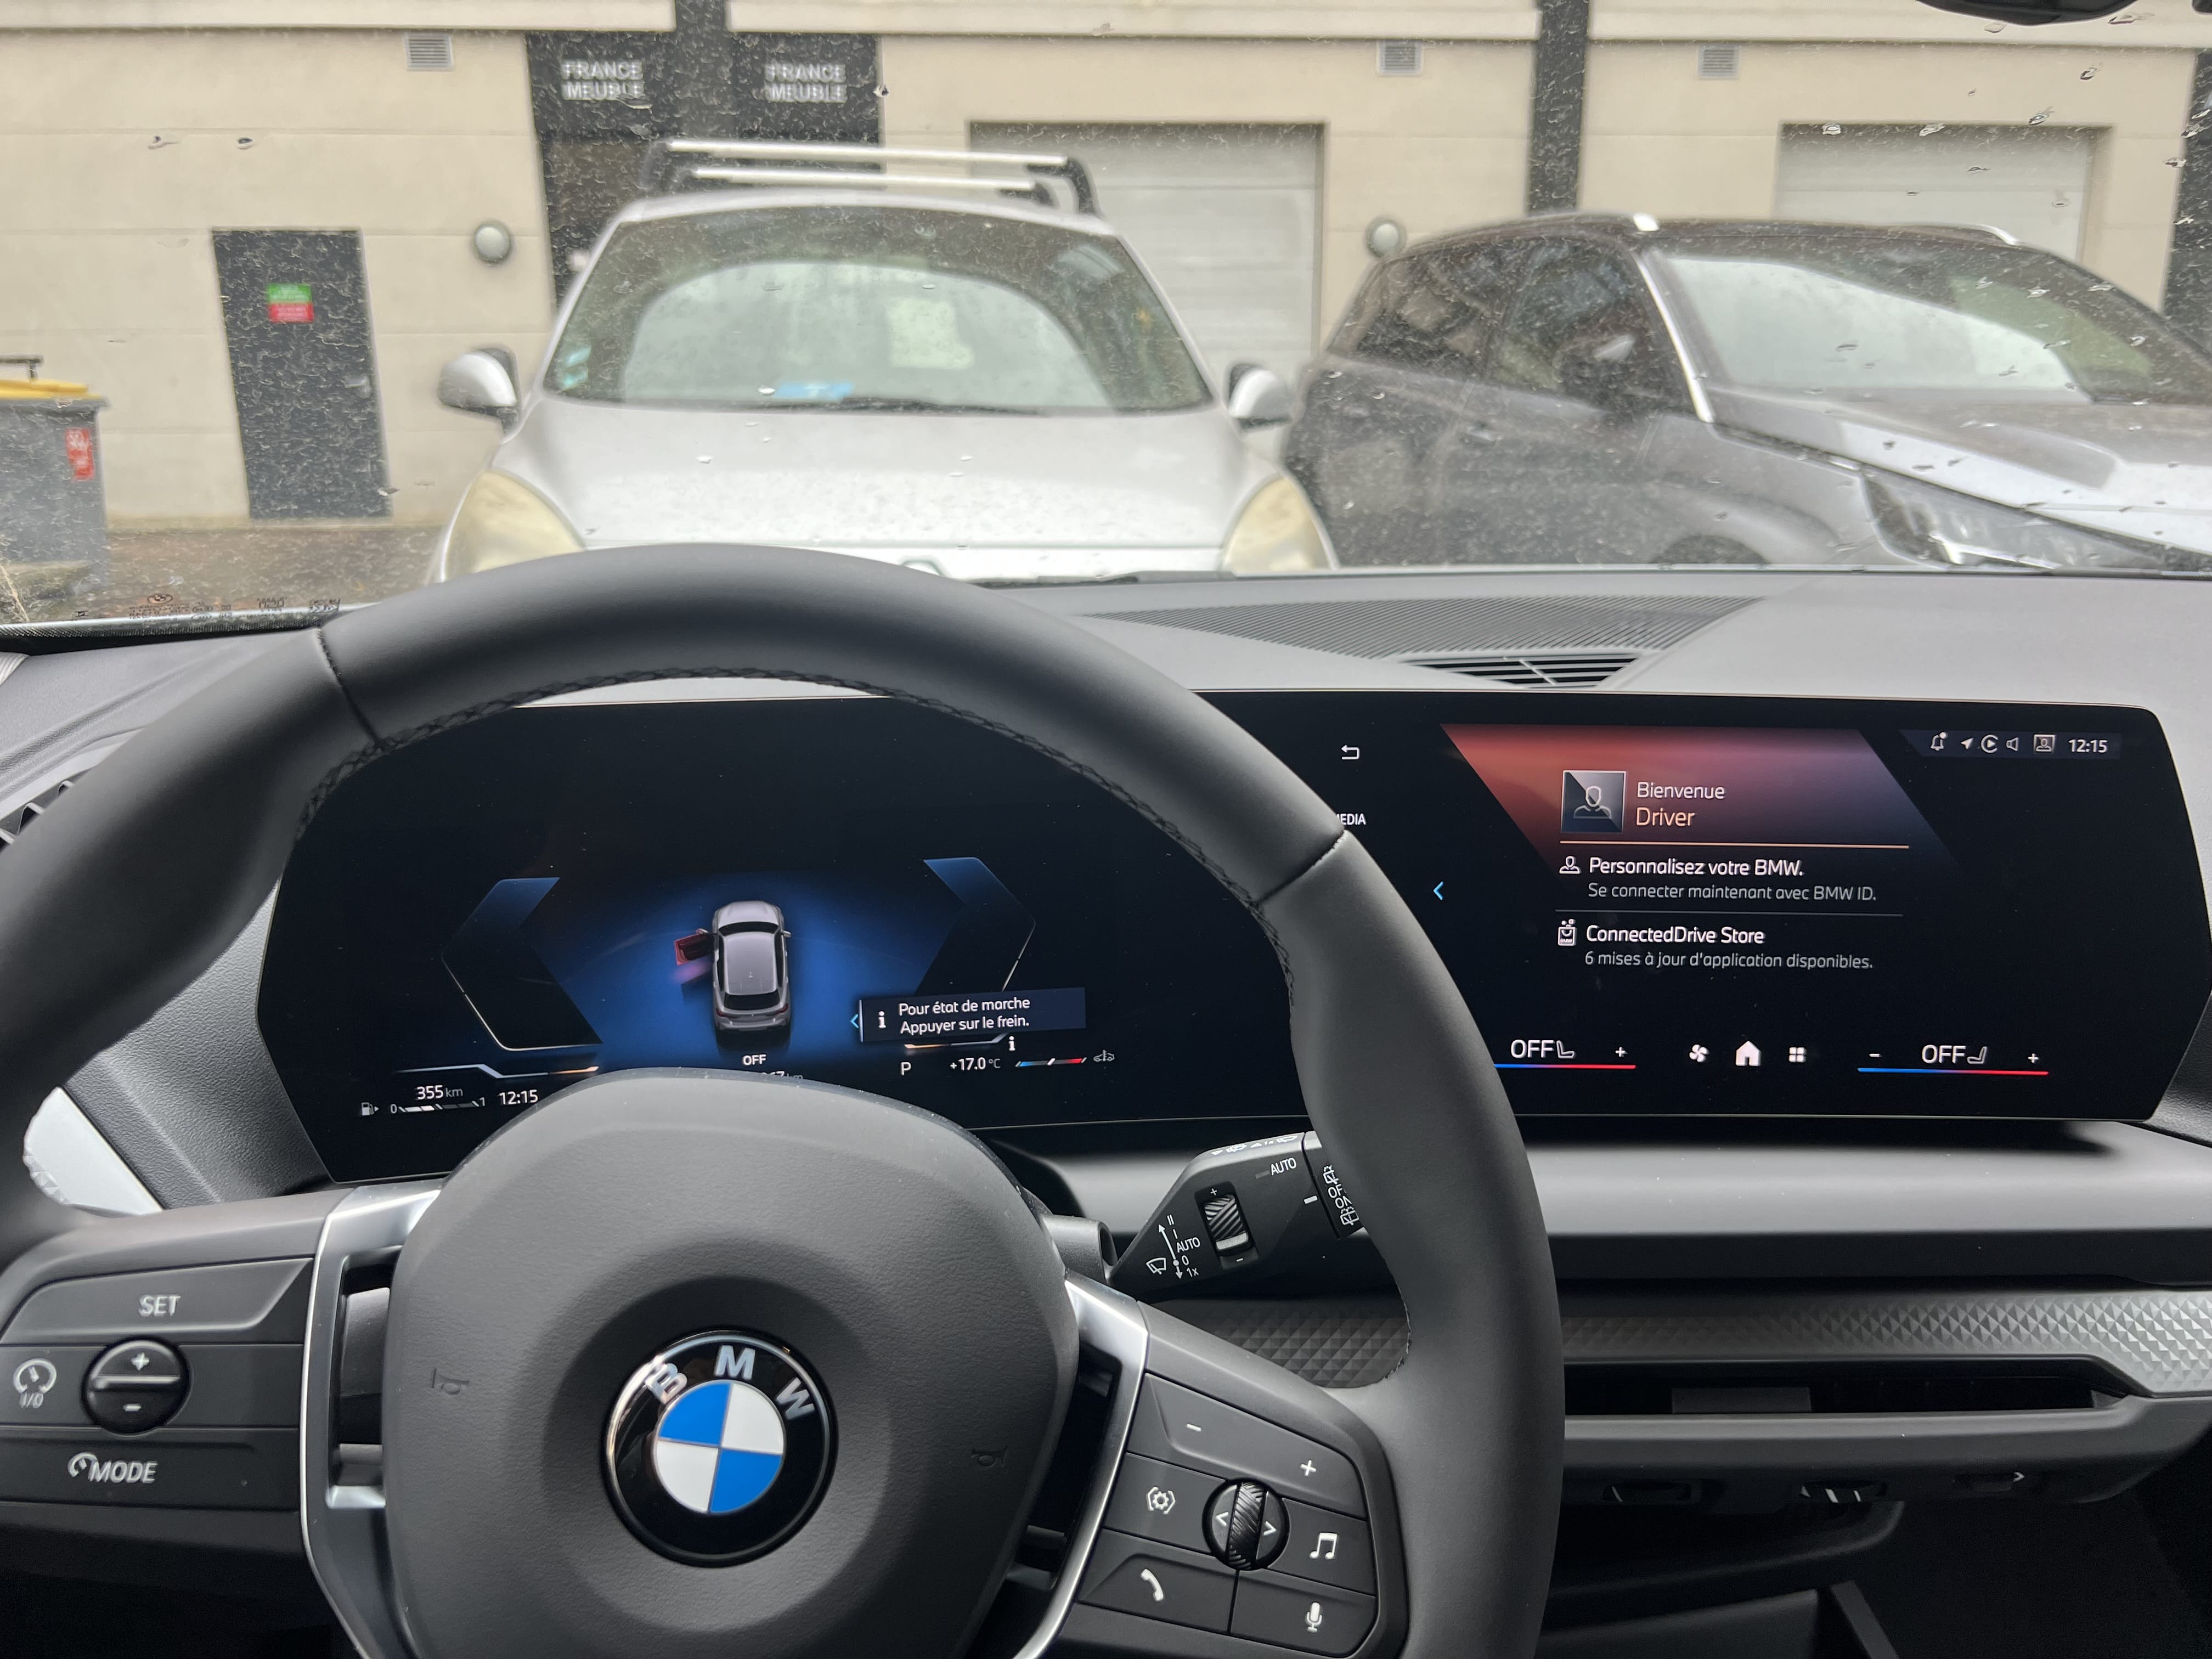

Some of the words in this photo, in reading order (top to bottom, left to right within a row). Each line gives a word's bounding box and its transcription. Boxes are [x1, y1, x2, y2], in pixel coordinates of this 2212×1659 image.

[562, 60, 643, 80] FRANCE
[765, 63, 847, 82] FRANCE
[562, 81, 645, 100] MEUBLE
[767, 82, 848, 103] MEUBLE
[2068, 739, 2108, 753] 12:15
[1637, 781, 1725, 799] Bienvenue
[1337, 814, 1366, 825] EDIA
[1636, 807, 1695, 827] Driver
[1589, 856, 1705, 875] Personnalisez
[1708, 861, 1750, 876] votre
[1754, 859, 1804, 876] BMW.
[1588, 882, 1607, 898] Se
[1611, 883, 1684, 899] connecter
[1688, 884, 1771, 900] maintenant
[1775, 888, 1809, 900] avec
[1813, 885, 1853, 900] BMW
[1857, 886, 1877, 901] ID.
[1586, 925, 1716, 943] ConnectedDrive
[1720, 927, 1765, 944] Store
[1585, 951, 1593, 966] 6
[1598, 951, 1640, 966] mises
[1645, 951, 1654, 966] à
[1656, 952, 1686, 969] jour
[1689, 952, 1782, 970] d'application
[1786, 953, 1874, 970] disponibles.
[899, 1003, 930, 1015] Pour
[933, 1001, 959, 1014] état
[961, 999, 978, 1012] de
[981, 996, 1031, 1011] marche
[900, 1021, 956, 1035] Appuyer
[960, 1019, 980, 1030] sur
[982, 1017, 994, 1028] le
[997, 1014, 1029, 1028] frein.
[1510, 1039, 1554, 1058] OFF
[1921, 1045, 1967, 1064] OFF
[743, 1054, 767, 1066] OFF
[900, 1062, 912, 1076] P
[950, 1057, 986, 1071] +17.0
[988, 1058, 1001, 1069] °C
[417, 1085, 444, 1099] 355
[445, 1086, 464, 1098] km
[499, 1090, 538, 1105] 12:15
[390, 1103, 397, 1114] 0
[1271, 1158, 1296, 1176] AUTO
[1328, 1184, 1346, 1198] OF
[1177, 1237, 1200, 1253] AUTO
[1187, 1267, 1199, 1277] 1x
[138, 1295, 180, 1316] SET
[645, 1345, 814, 1420] BMW
[88, 1462, 157, 1483] MODE
